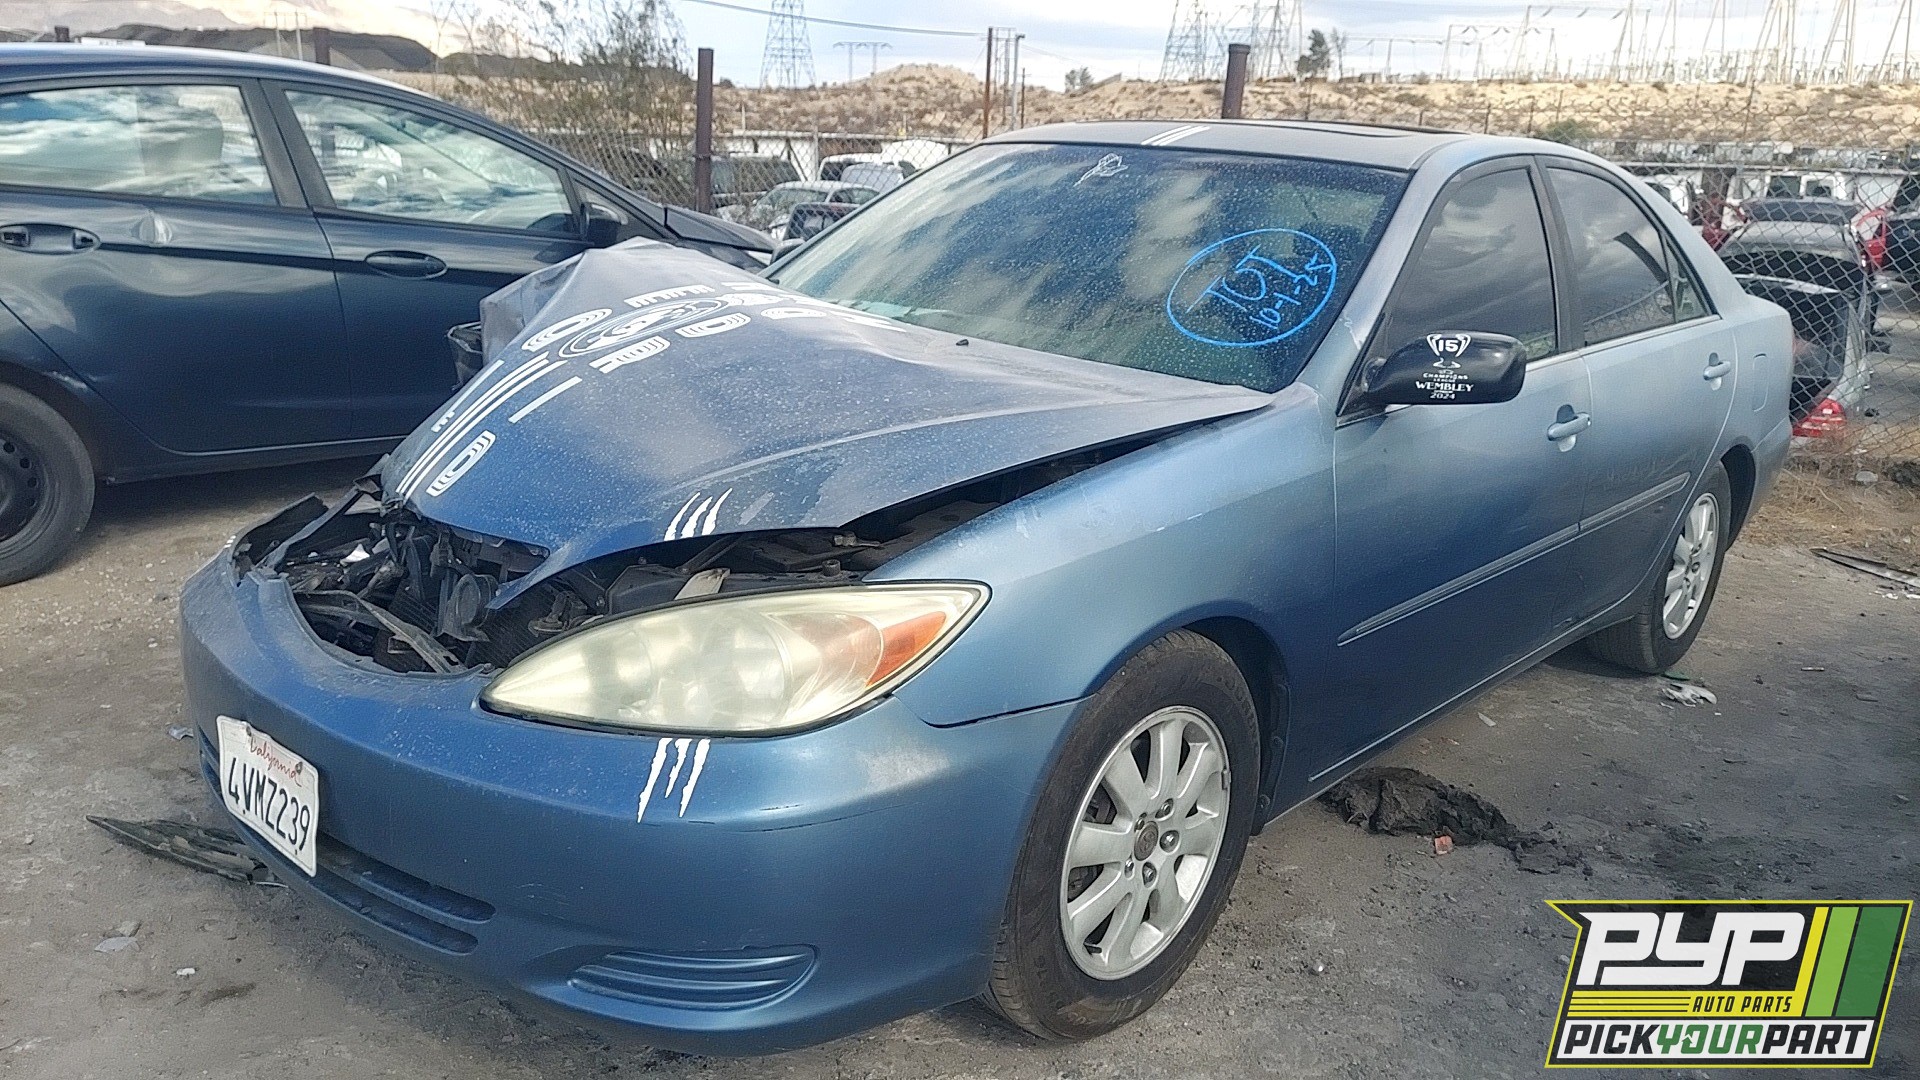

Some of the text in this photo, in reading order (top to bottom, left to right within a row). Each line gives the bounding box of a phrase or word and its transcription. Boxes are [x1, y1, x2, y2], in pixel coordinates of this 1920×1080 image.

[1438, 339, 1459, 352] 15
[1415, 381, 1474, 392] WEMBLEY
[228, 757, 311, 852] 4VMZ239
